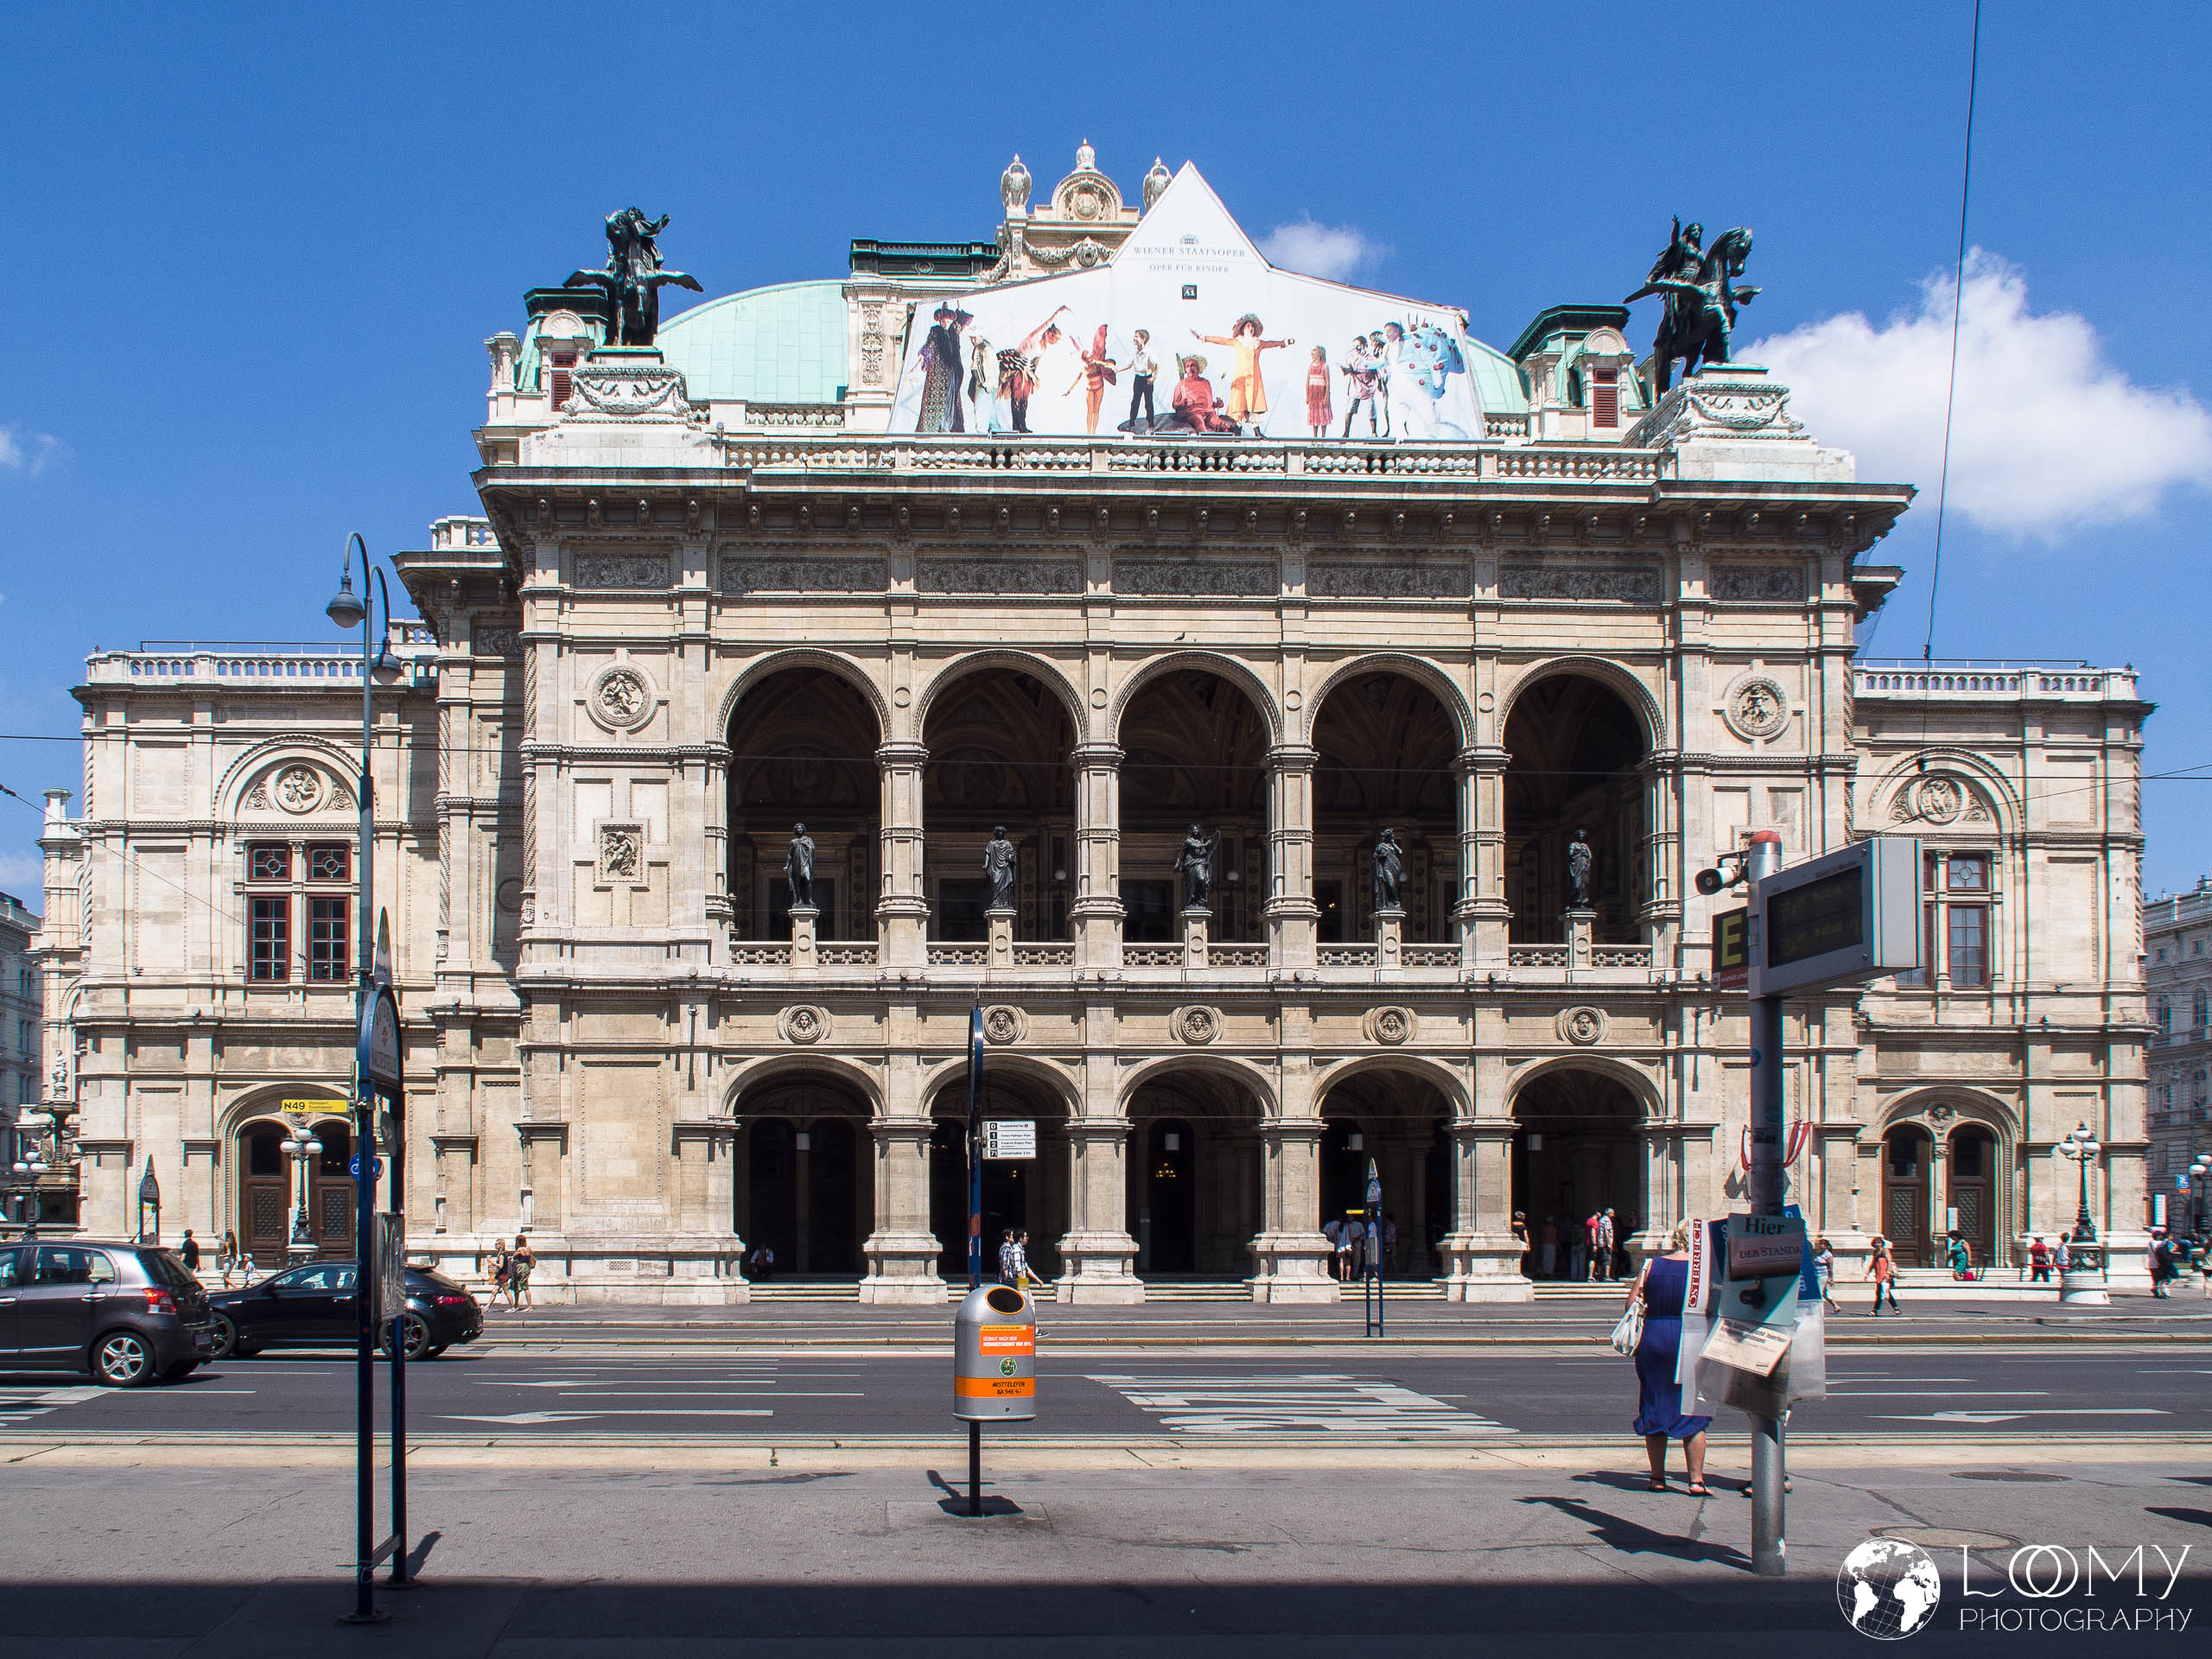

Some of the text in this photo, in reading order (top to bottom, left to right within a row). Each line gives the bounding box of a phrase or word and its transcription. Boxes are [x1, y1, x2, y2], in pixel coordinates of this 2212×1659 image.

[1134, 246, 1245, 257] WIENER STAATSOPER
[1196, 264, 1229, 273] KINDER
[1720, 913, 1743, 967] E
[283, 1101, 305, 1110] N49
[1745, 1217, 1785, 1235] Hier
[1739, 1249, 1760, 1259] DER
[1688, 1219, 1701, 1307] ÖSTERREICH
